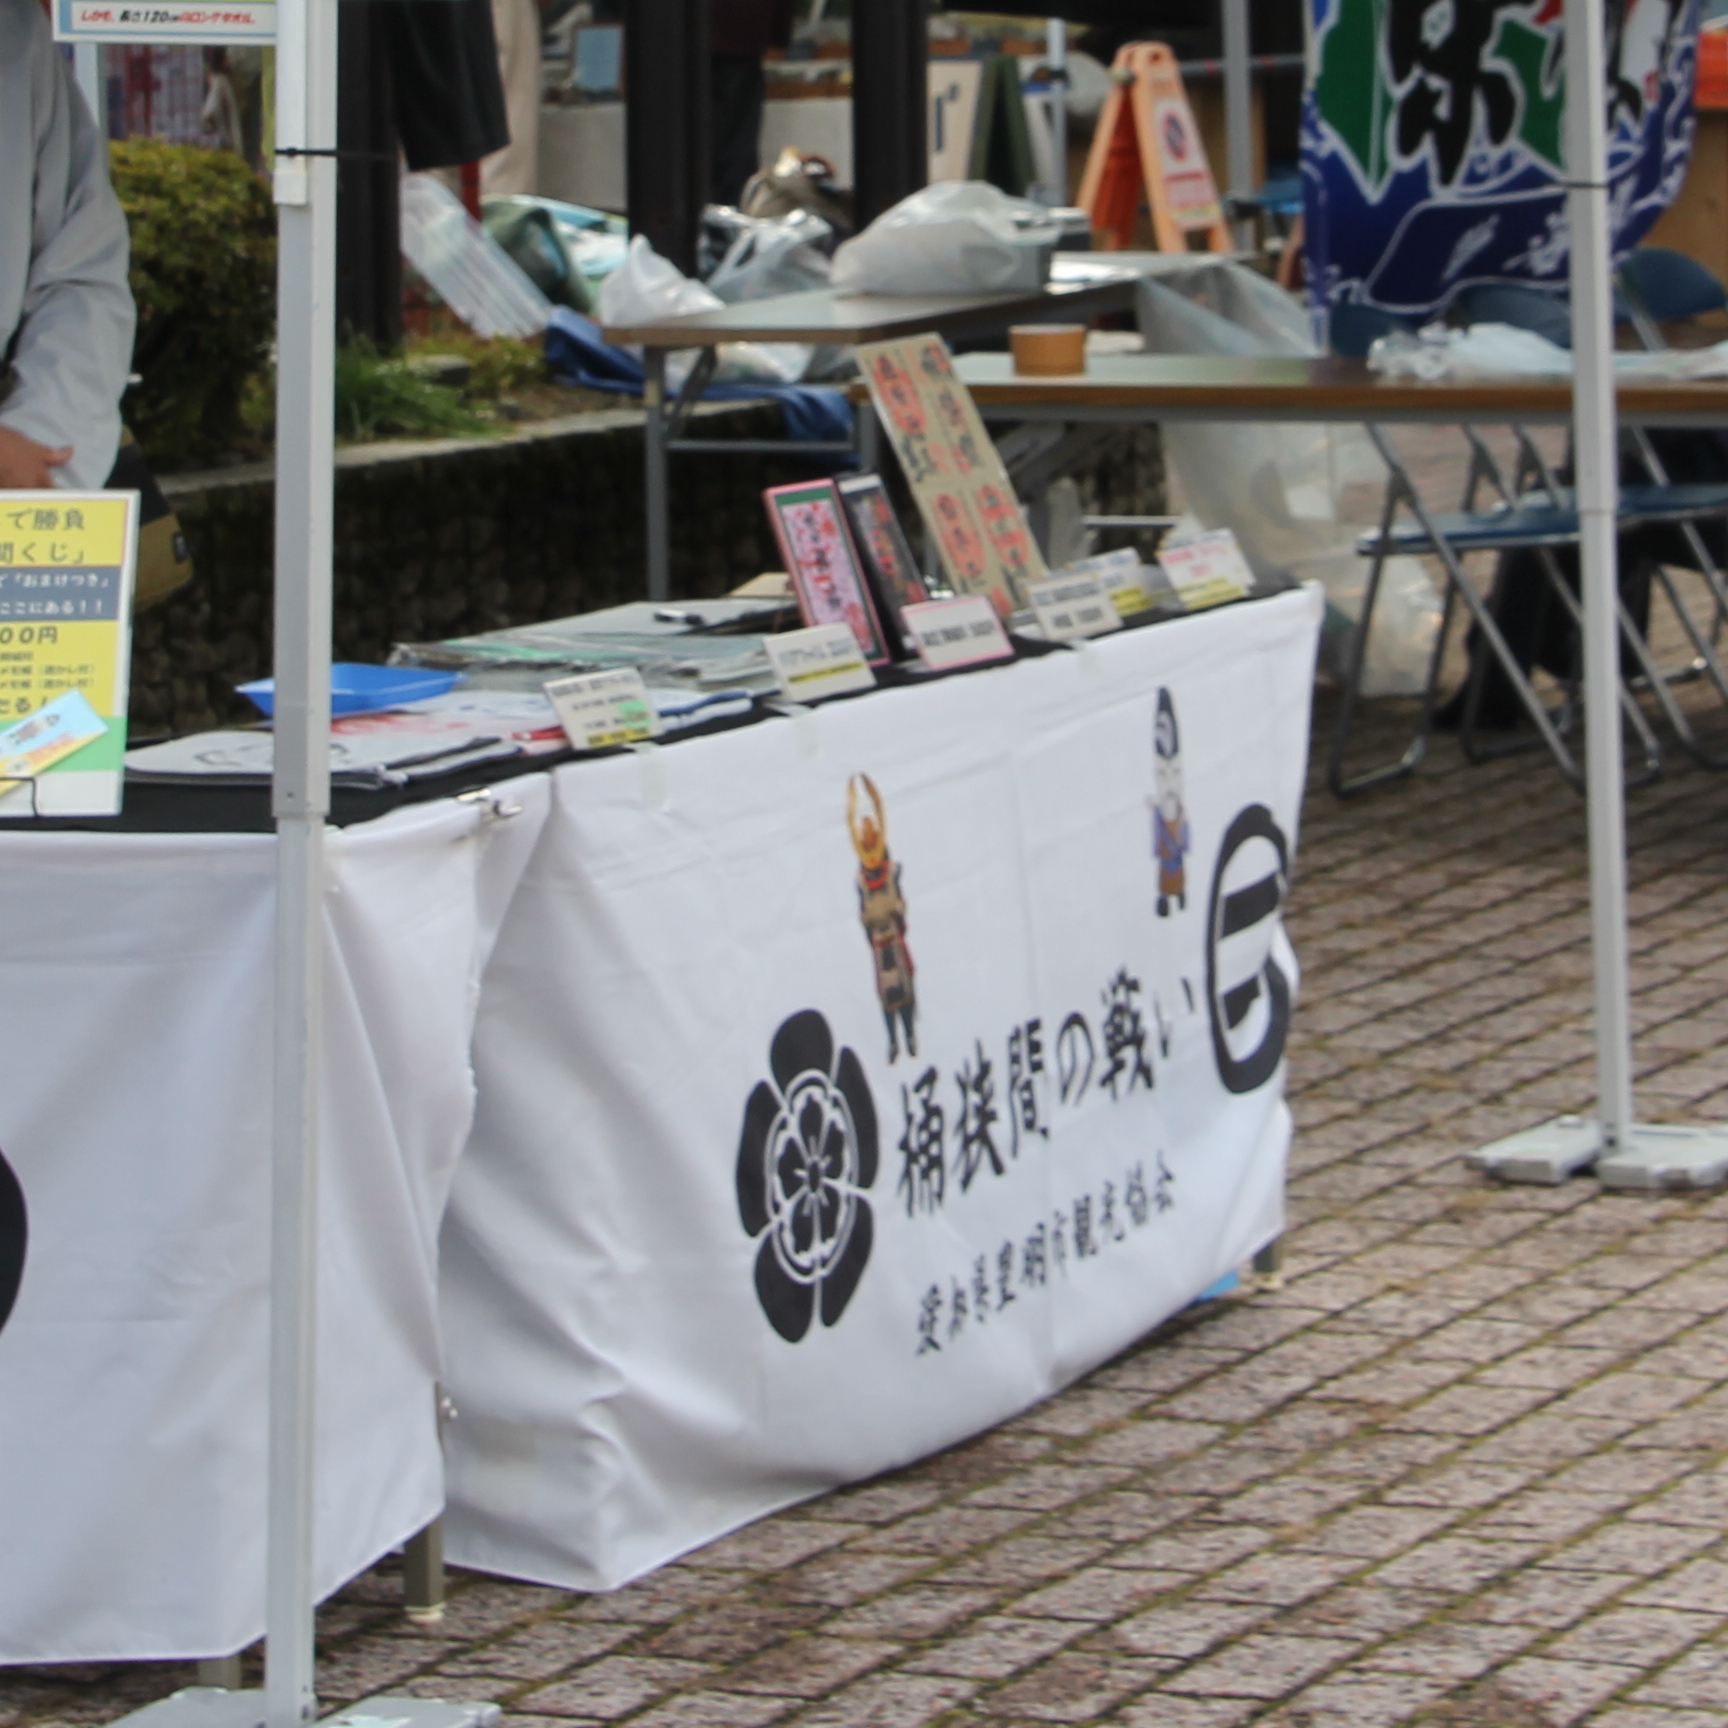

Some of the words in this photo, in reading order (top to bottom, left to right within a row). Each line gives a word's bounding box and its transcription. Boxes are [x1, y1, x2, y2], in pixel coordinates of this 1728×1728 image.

[897, 966, 1194, 1219] 桶狭間の戦い
